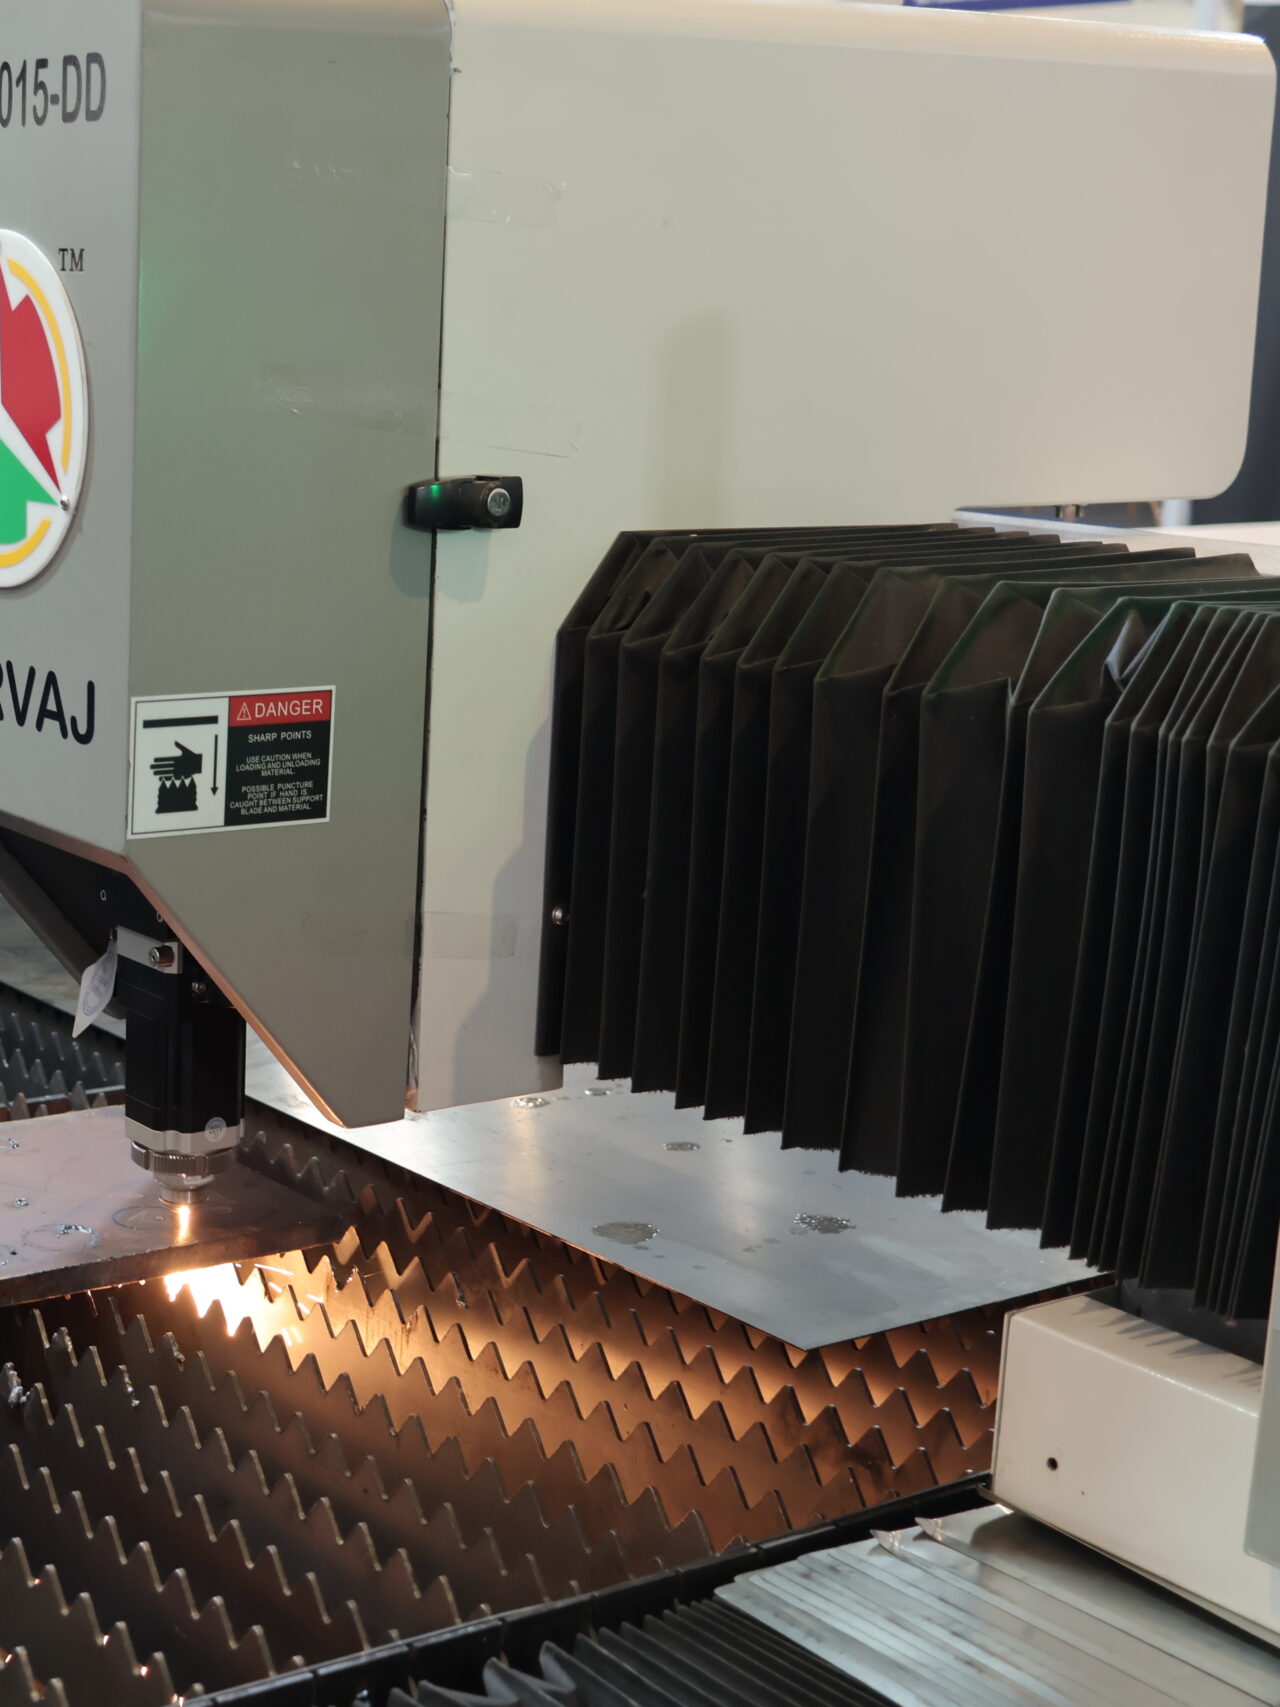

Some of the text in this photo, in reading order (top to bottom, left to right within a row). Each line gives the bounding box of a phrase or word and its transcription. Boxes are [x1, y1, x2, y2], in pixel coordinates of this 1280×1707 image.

[58, 248, 85, 272] TM
[255, 699, 323, 718] DANGER
[248, 730, 312, 743] SHARP POINTS
[246, 752, 312, 764] USE CAUTION WHEN
[235, 758, 321, 772] LOADING AND UNLOADING
[261, 768, 296, 777] MATERIAL.
[241, 781, 314, 793] POSSIBLE PUNCTURE
[247, 788, 308, 800] POINT IF HAND IS
[229, 794, 324, 809] CAUGHT BETWEEN SUPPORT
[240, 806, 263, 816] BLADE
[263, 805, 278, 813] AND
